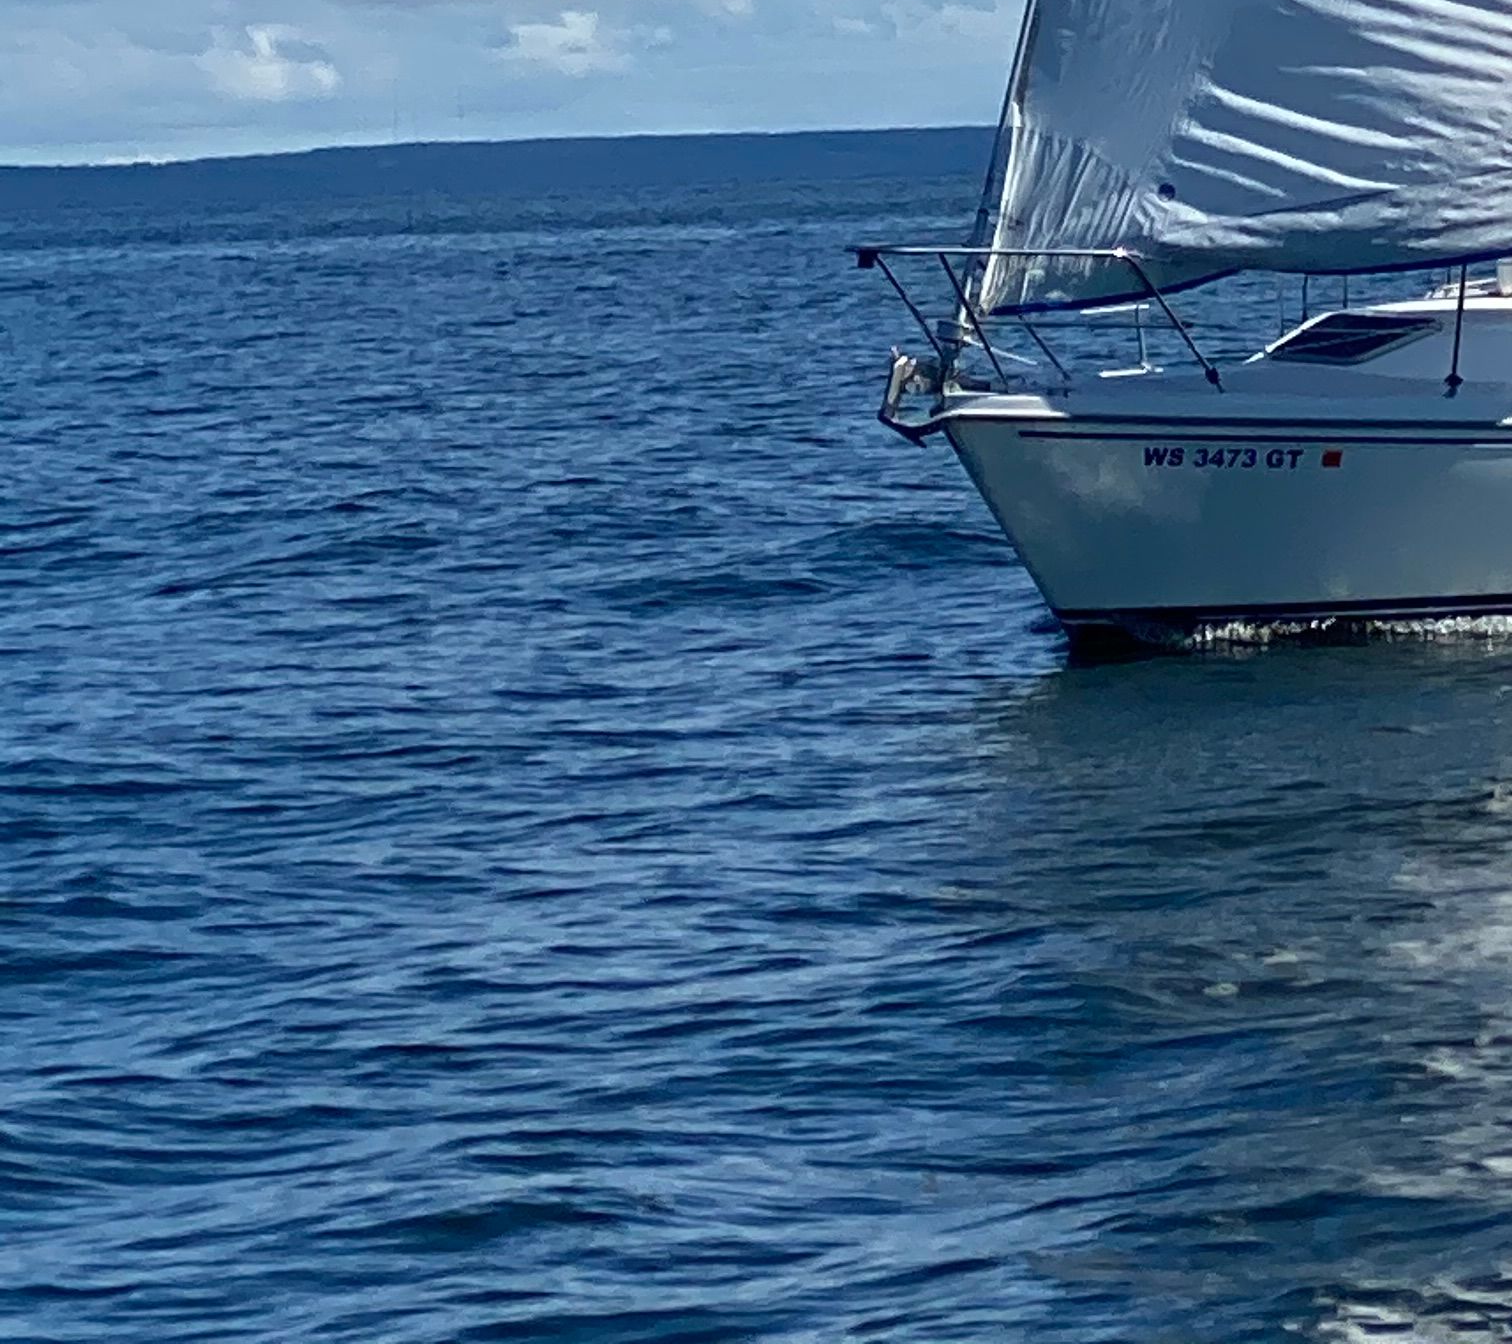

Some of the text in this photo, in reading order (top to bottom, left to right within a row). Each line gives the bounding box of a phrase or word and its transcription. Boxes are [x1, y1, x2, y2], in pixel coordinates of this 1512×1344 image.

[1143, 446, 1304, 469] WS 3473 GT
